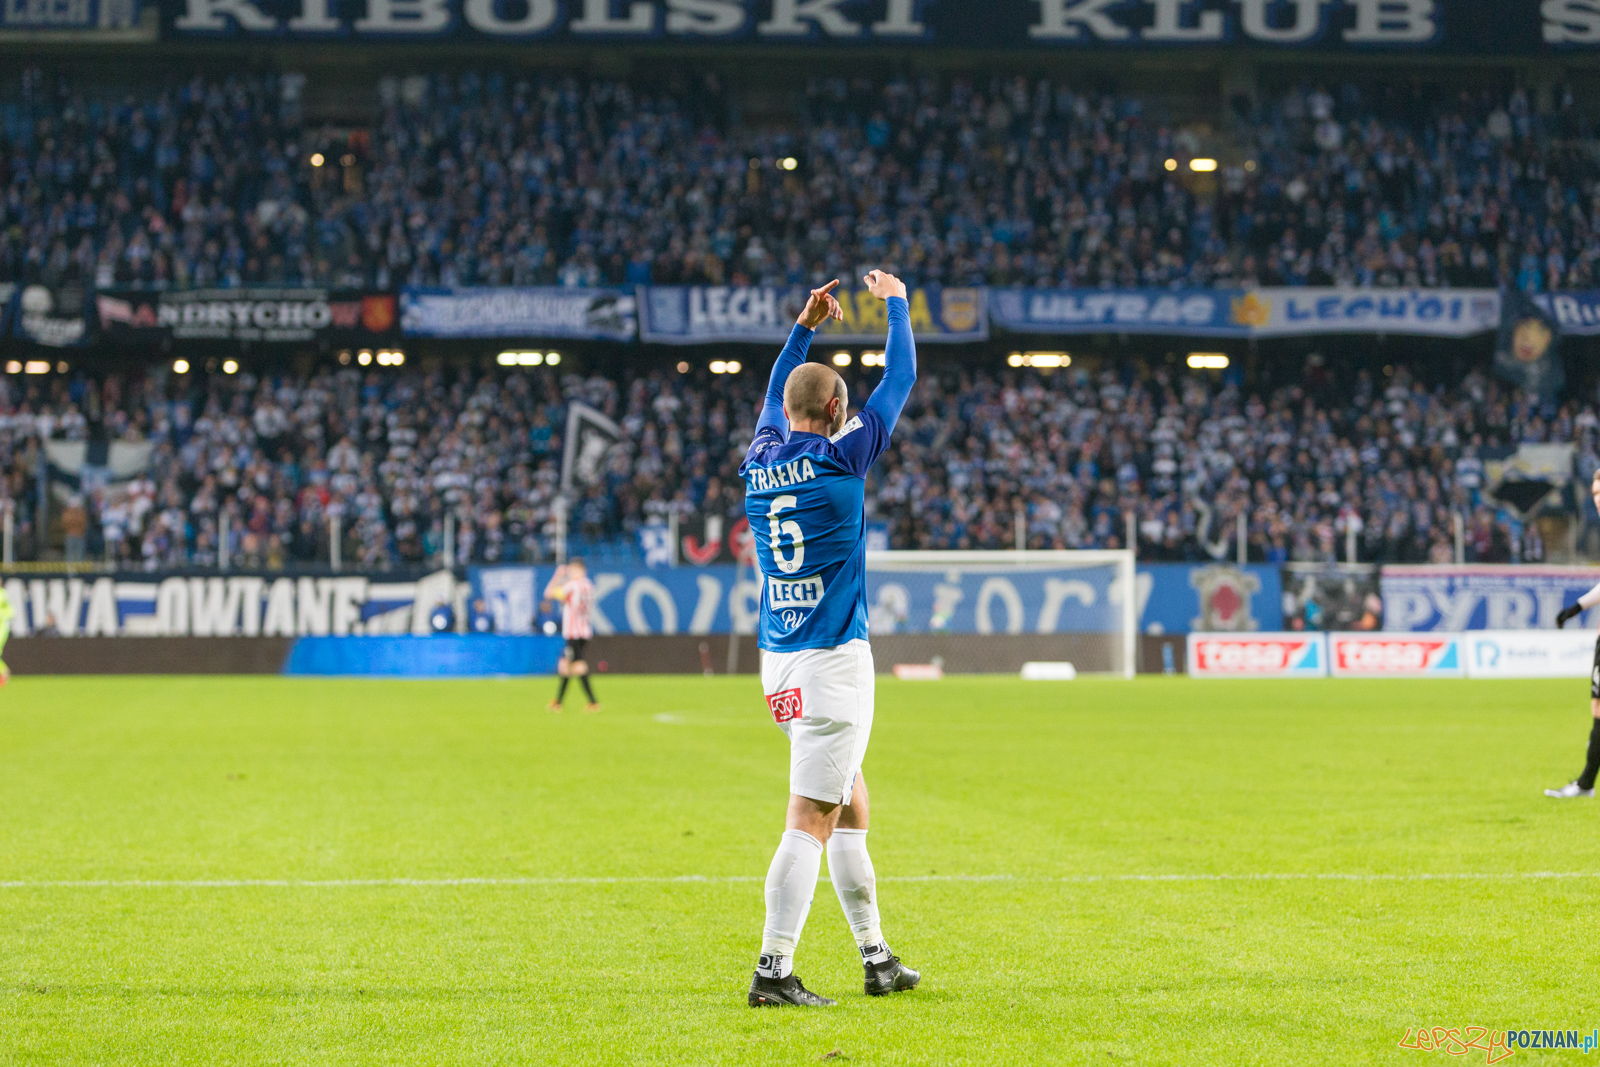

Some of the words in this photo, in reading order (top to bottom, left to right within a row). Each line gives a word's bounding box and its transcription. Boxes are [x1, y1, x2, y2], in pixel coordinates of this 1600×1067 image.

[174, 0, 926, 35] KIBOLSKI
[1028, 0, 1438, 42] KLUB
[689, 286, 777, 324] LECH
[748, 458, 817, 491] TRAŁKA
[766, 494, 805, 574] 6
[772, 582, 818, 602] LECH
